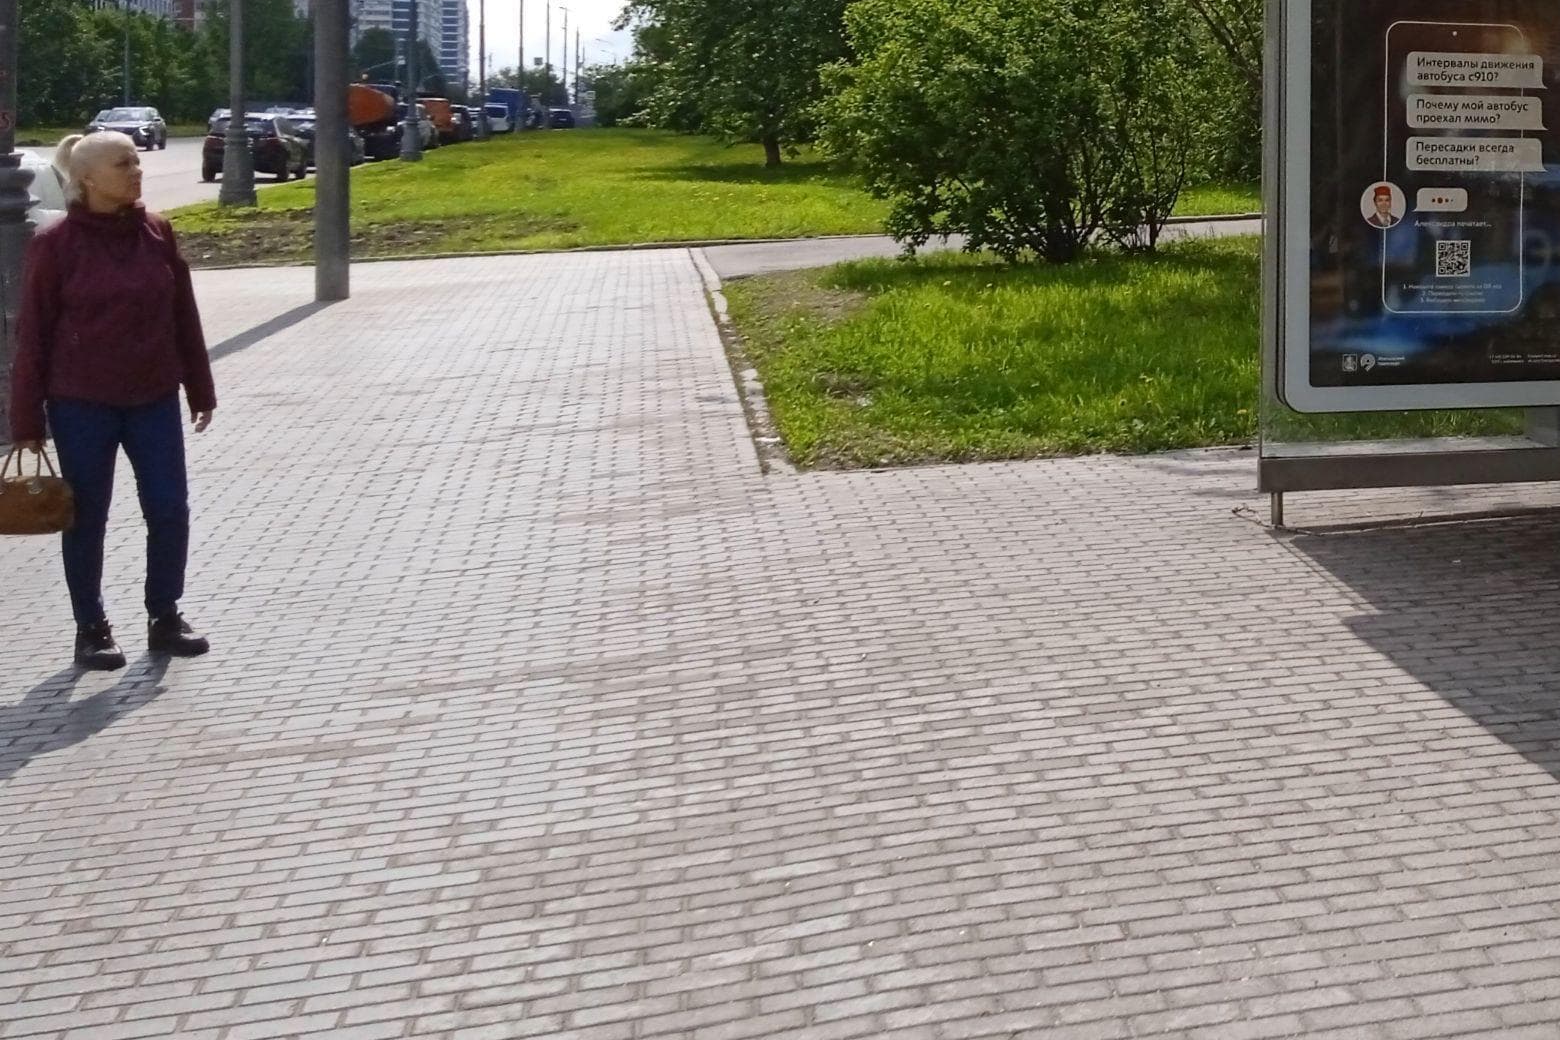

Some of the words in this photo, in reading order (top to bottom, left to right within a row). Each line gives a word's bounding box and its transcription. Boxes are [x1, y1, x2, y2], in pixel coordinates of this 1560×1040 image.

[1416, 56, 1479, 70] Интервалы
[1480, 60, 1535, 70] движения
[1416, 70, 1466, 84] автобуса
[1468, 71, 1499, 82] с910?
[1416, 98, 1459, 112] Почему
[1461, 99, 1484, 111] мой
[1486, 100, 1529, 114] автобус
[1416, 113, 1462, 124] проехал
[1464, 113, 1501, 124] мимо?
[1416, 141, 1476, 154] Пересадки
[1479, 145, 1515, 154] всегда
[1416, 154, 1480, 166] бесплатны?
